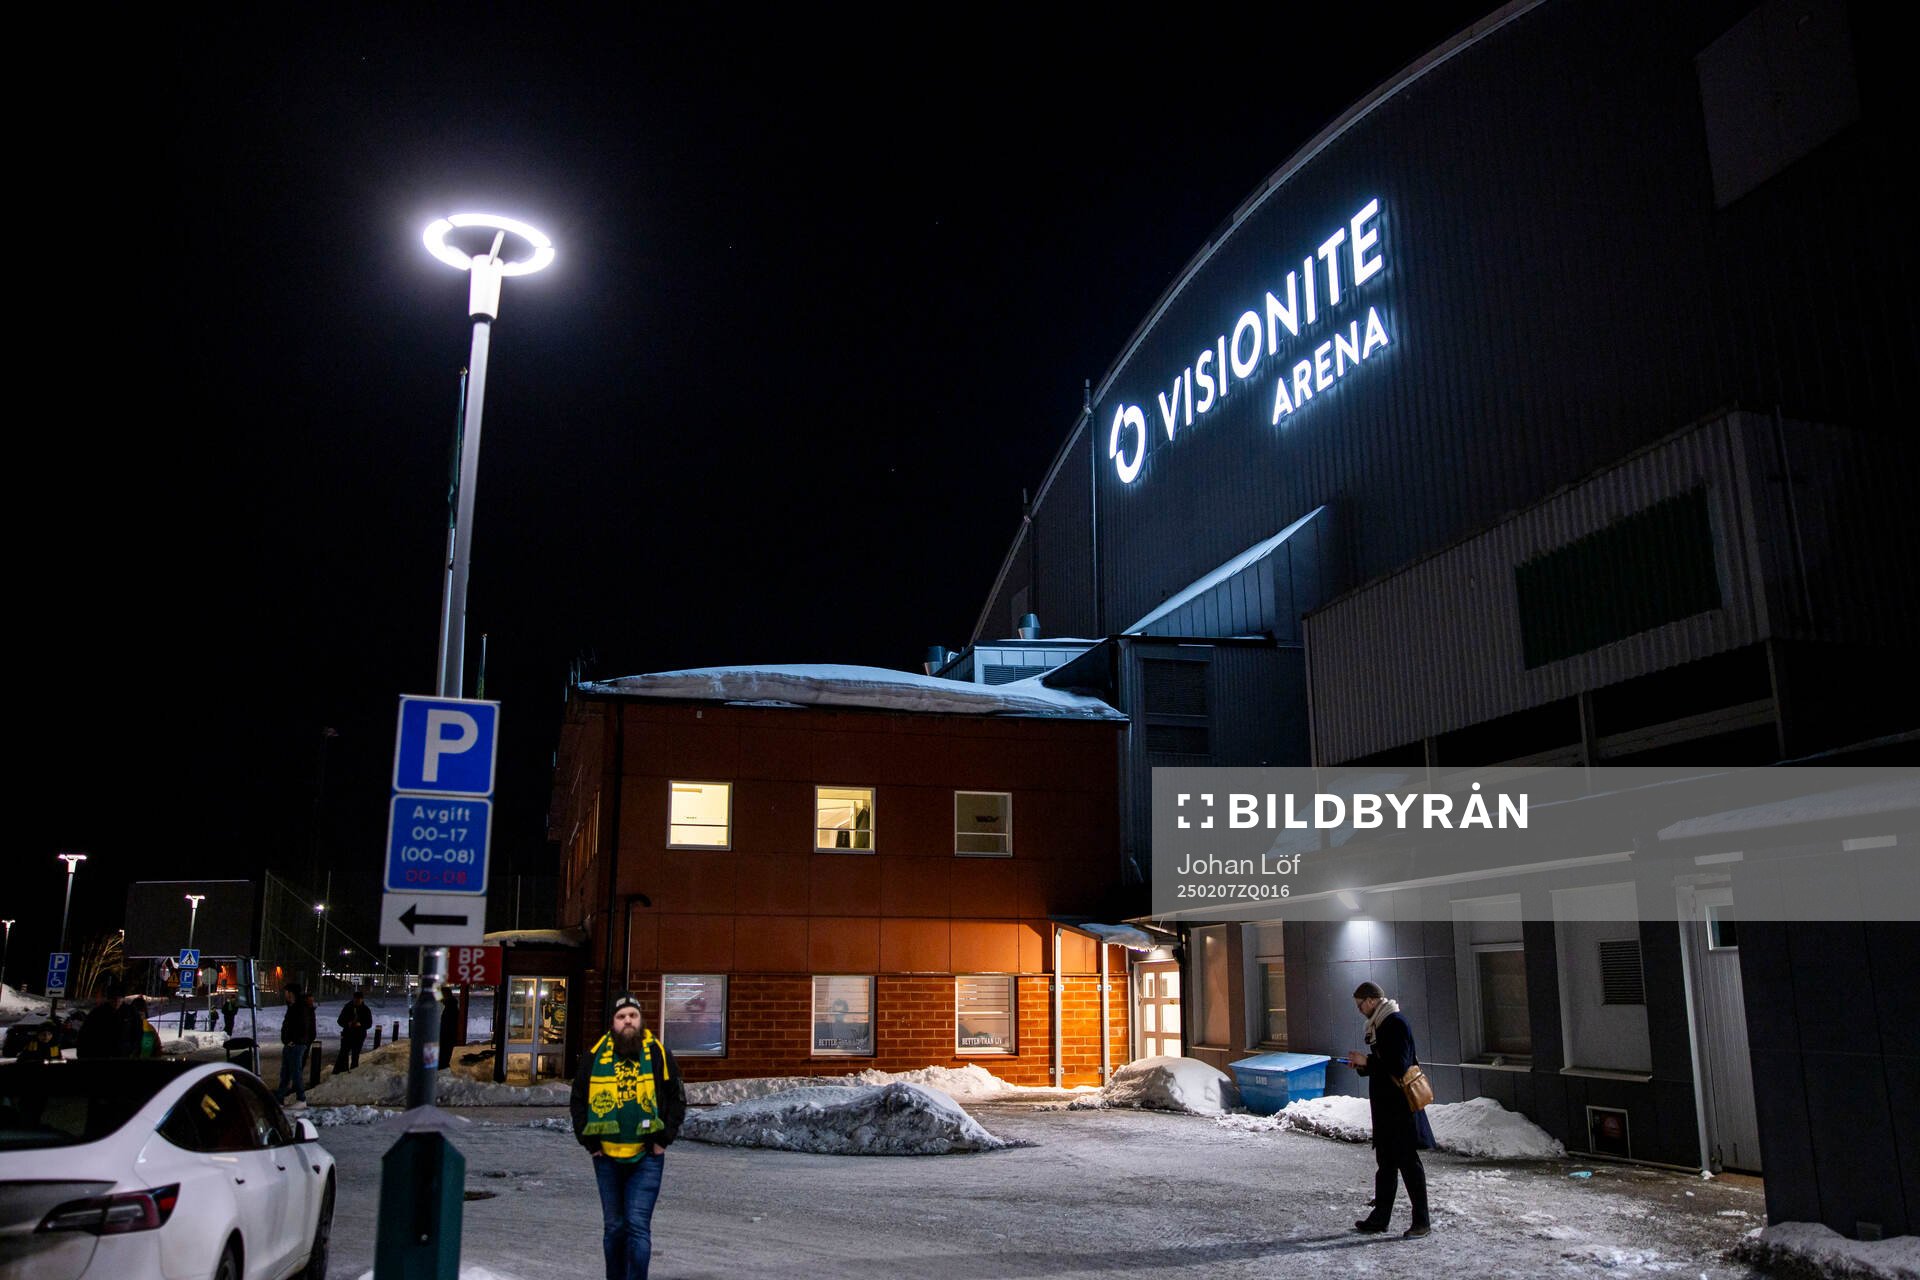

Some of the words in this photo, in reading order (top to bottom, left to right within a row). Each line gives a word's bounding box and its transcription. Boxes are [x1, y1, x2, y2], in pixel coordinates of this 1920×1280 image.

[1158, 197, 1383, 441] VISIONITE
[1272, 306, 1389, 425] ARENA
[422, 709, 478, 783] P
[413, 805, 470, 823] Avgift
[412, 826, 468, 842] 00-17
[401, 846, 475, 864] (00-08)
[54, 955, 65, 969] P
[458, 948, 485, 965] BP
[184, 972, 191, 982] P
[457, 966, 485, 984] 9,2
